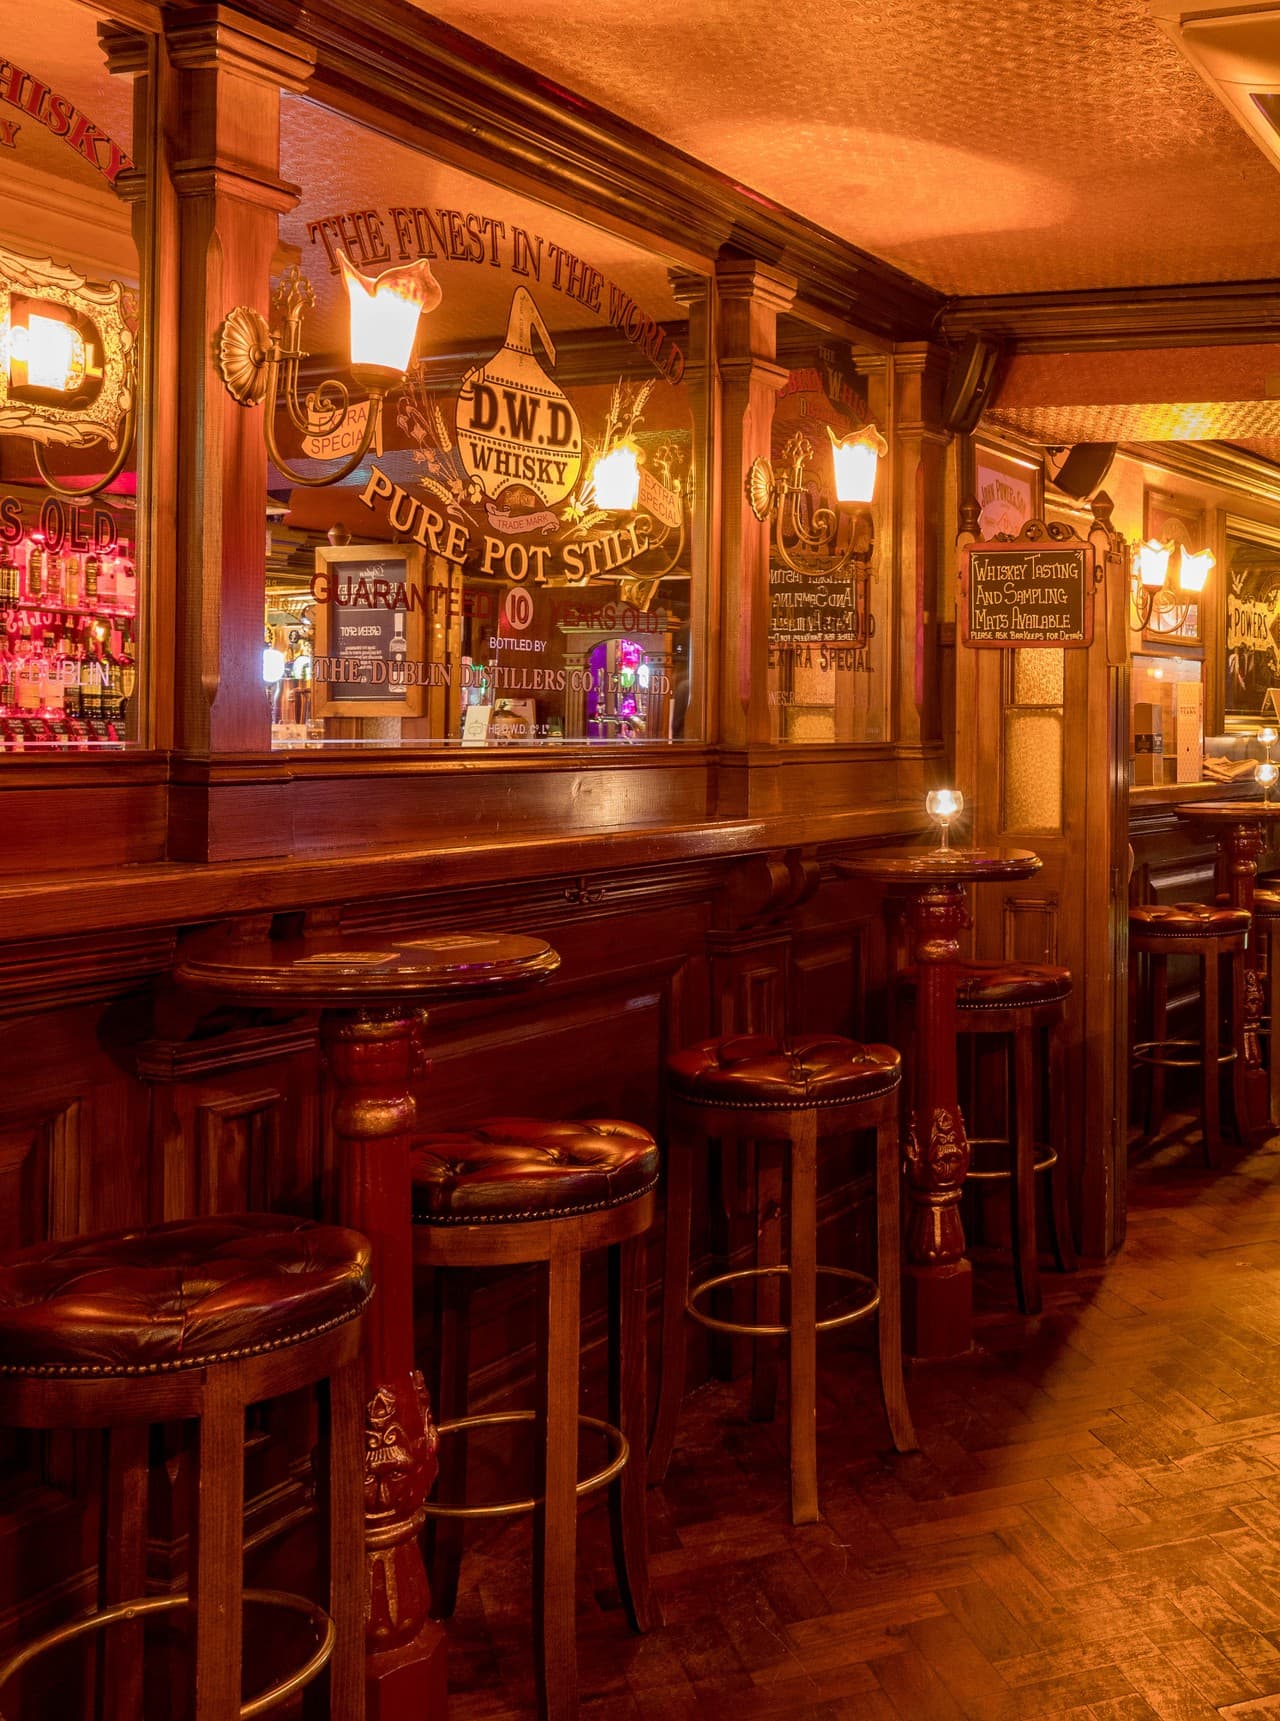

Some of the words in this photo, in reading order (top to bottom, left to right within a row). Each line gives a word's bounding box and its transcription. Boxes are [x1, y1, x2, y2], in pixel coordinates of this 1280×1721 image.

[306, 209, 391, 276] THE
[389, 207, 506, 268] FINEST
[511, 226, 544, 282] IN
[548, 241, 605, 314] THE
[607, 280, 685, 384] WORLD
[469, 381, 578, 450] D.W.D.
[311, 429, 364, 454] SPECIA
[469, 443, 568, 486] WHISKY
[40, 495, 118, 554] OLD
[358, 464, 471, 566] PURE
[480, 535, 552, 583] POT
[563, 523, 651, 582] STILL
[498, 517, 524, 530] TRADE
[526, 513, 548, 527] MARK
[974, 558, 1028, 581] WHISKEY
[1024, 553, 1079, 580] TASTING
[310, 572, 495, 620] GUARANTEED
[510, 594, 530, 624] 10
[975, 584, 1003, 606] AND
[1003, 581, 1069, 605] SAMPLING
[975, 608, 1009, 631] MATS
[1011, 605, 1071, 630] AVAILABLE
[489, 637, 533, 652] BOTTLED
[534, 639, 547, 653] BY
[314, 655, 362, 683] THE
[371, 660, 453, 687] DUBLIN
[460, 663, 567, 691] DISTILLERS
